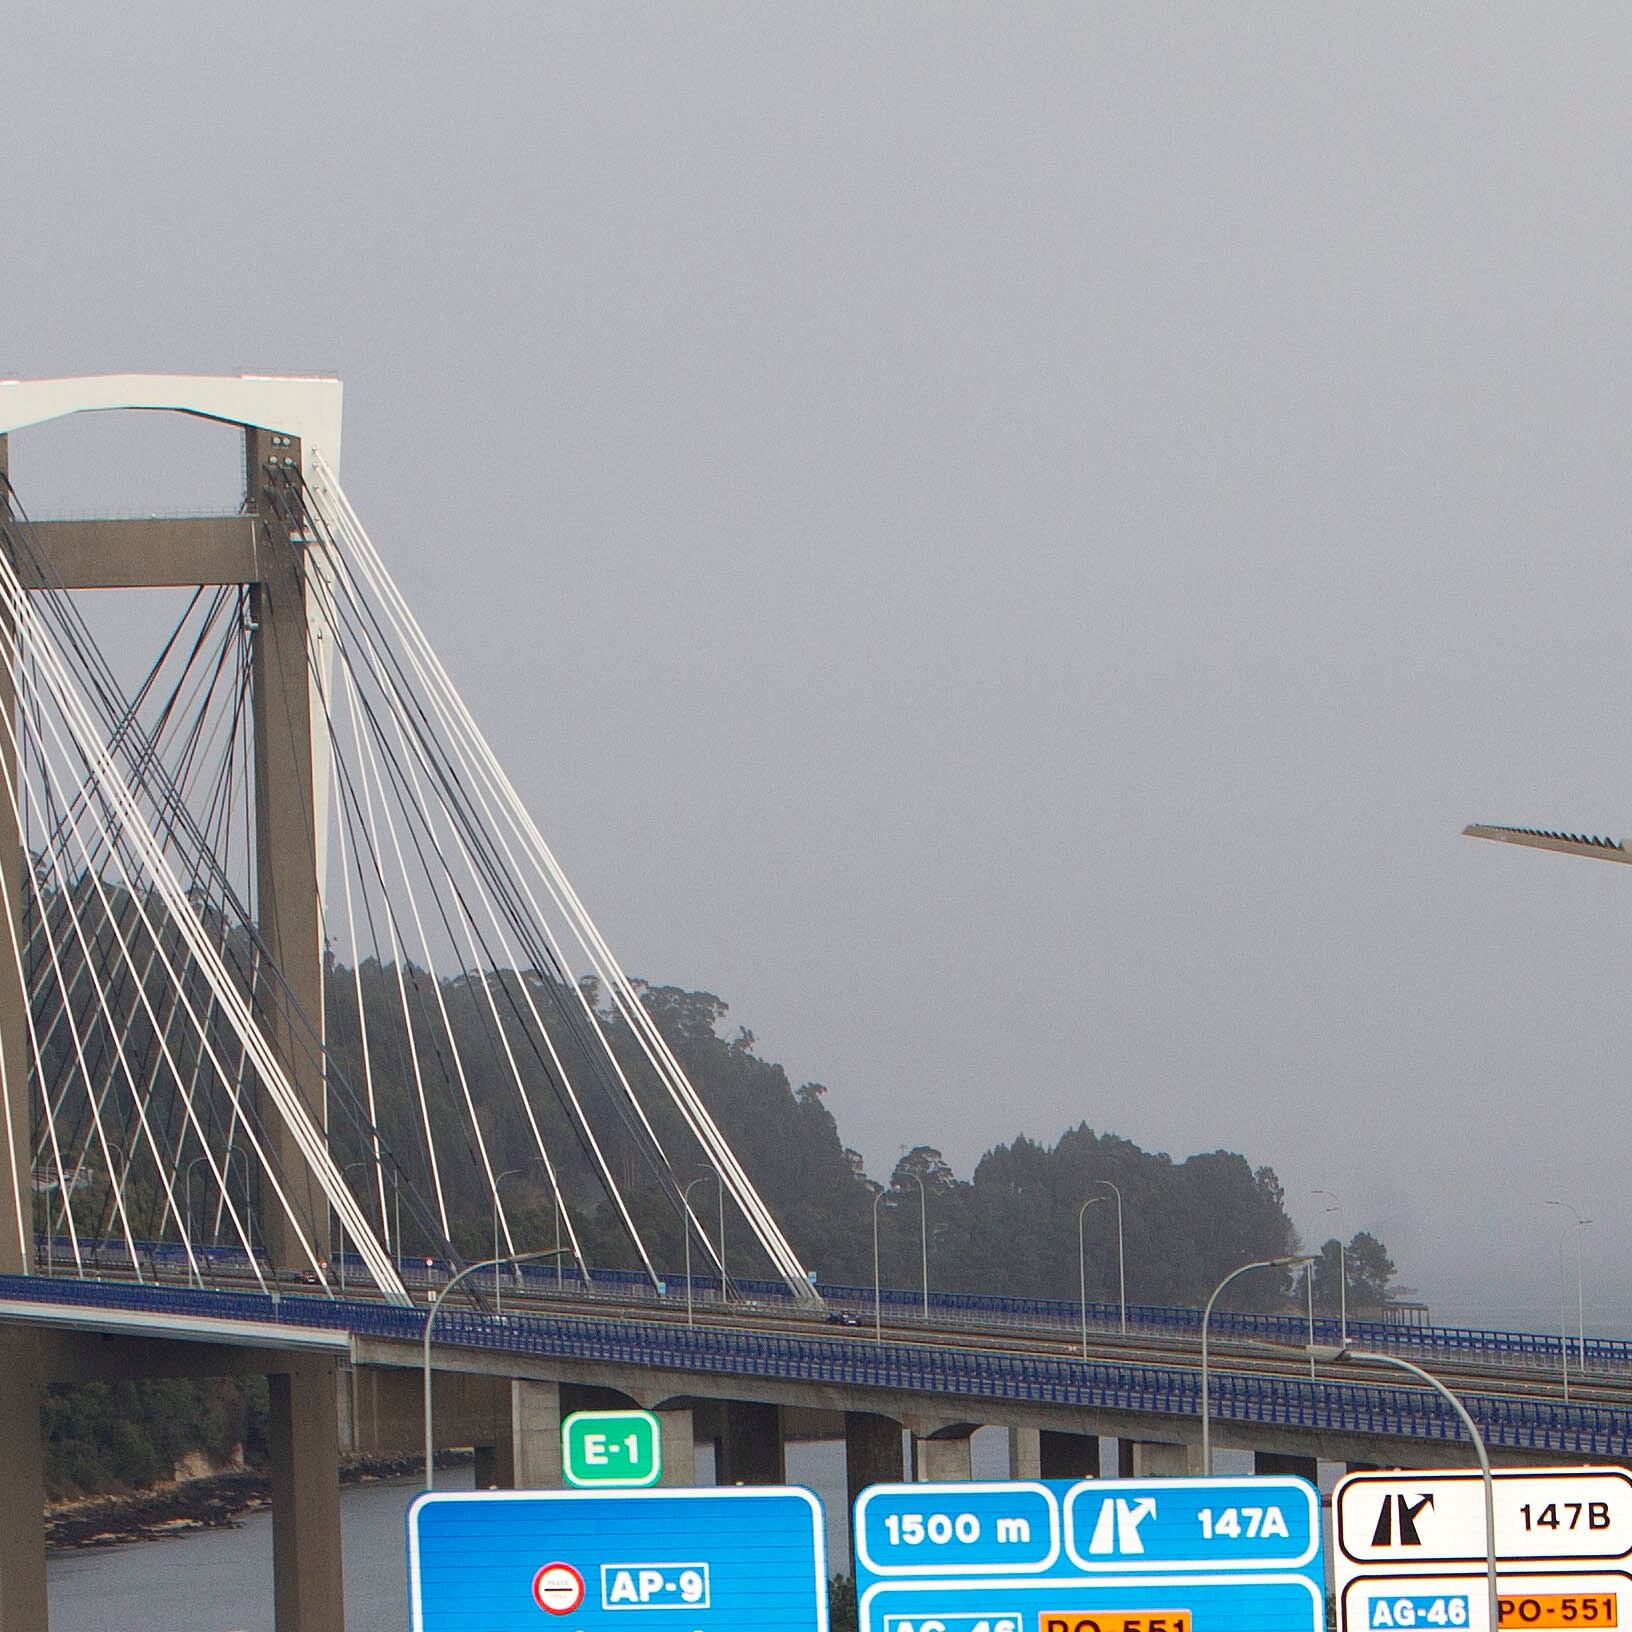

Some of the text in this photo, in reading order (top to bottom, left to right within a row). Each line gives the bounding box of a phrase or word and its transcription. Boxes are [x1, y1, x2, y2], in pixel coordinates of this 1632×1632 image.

[584, 1433, 639, 1465] E-1
[884, 1514, 1031, 1546] 1500 m
[1197, 1506, 1289, 1539] 147A
[1519, 1501, 1612, 1531] 147B
[609, 1570, 704, 1603] AP-9
[1372, 1598, 1467, 1626] AG-46
[1499, 1597, 1614, 1624] PO-551
